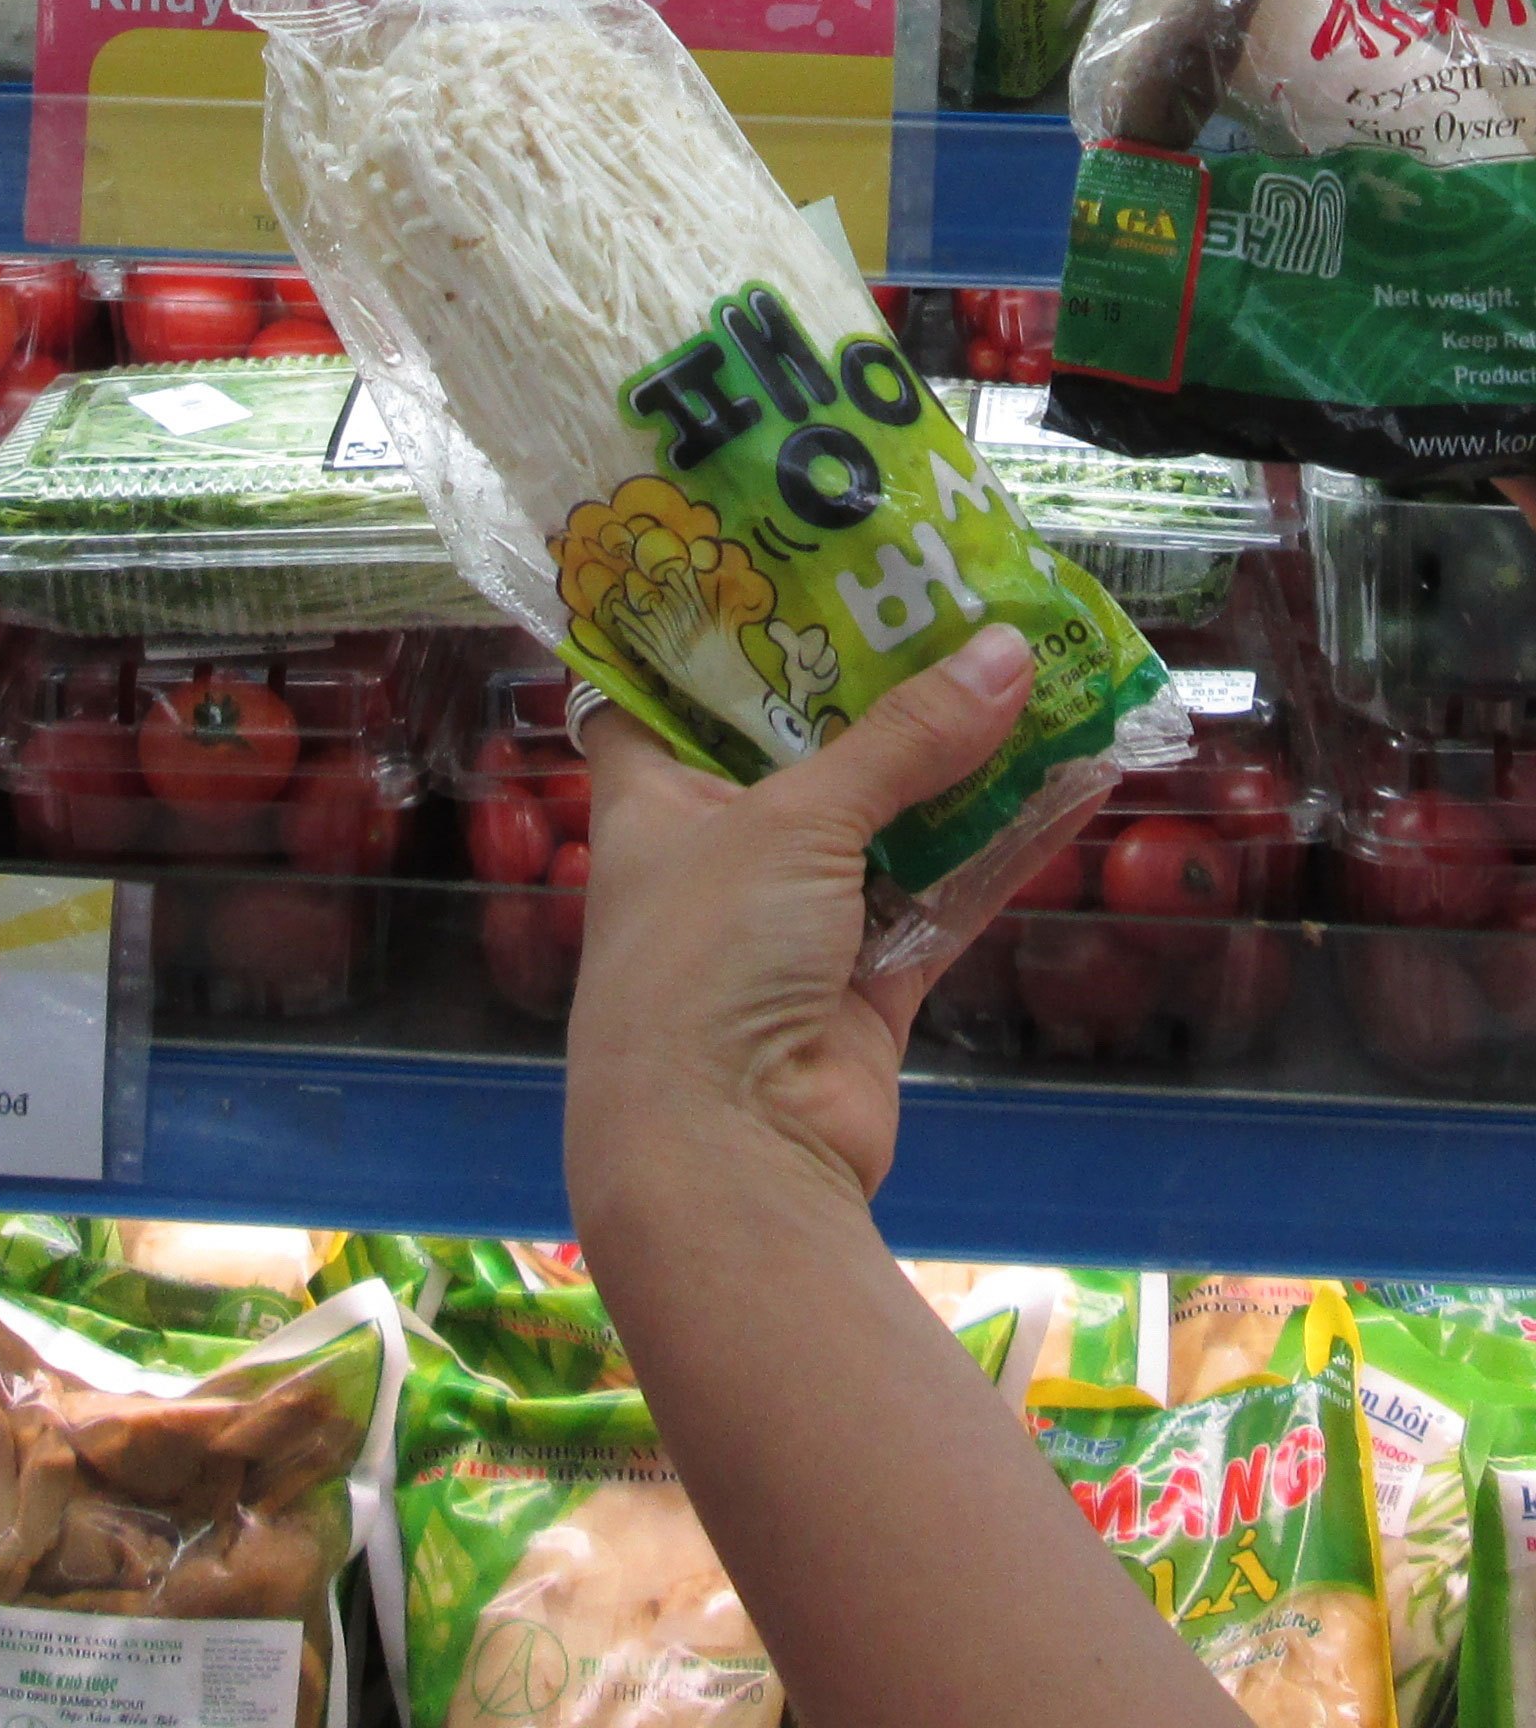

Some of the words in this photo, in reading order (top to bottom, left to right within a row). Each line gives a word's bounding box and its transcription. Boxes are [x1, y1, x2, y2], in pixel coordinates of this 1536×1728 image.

[1432, 110, 1526, 143] Oyster
[1373, 283, 1421, 308] Net
[1426, 284, 1520, 315] weight.
[1441, 331, 1498, 353] Keep
[1040, 689, 1103, 733] KOREA
[1384, 1393, 1437, 1439] bôi
